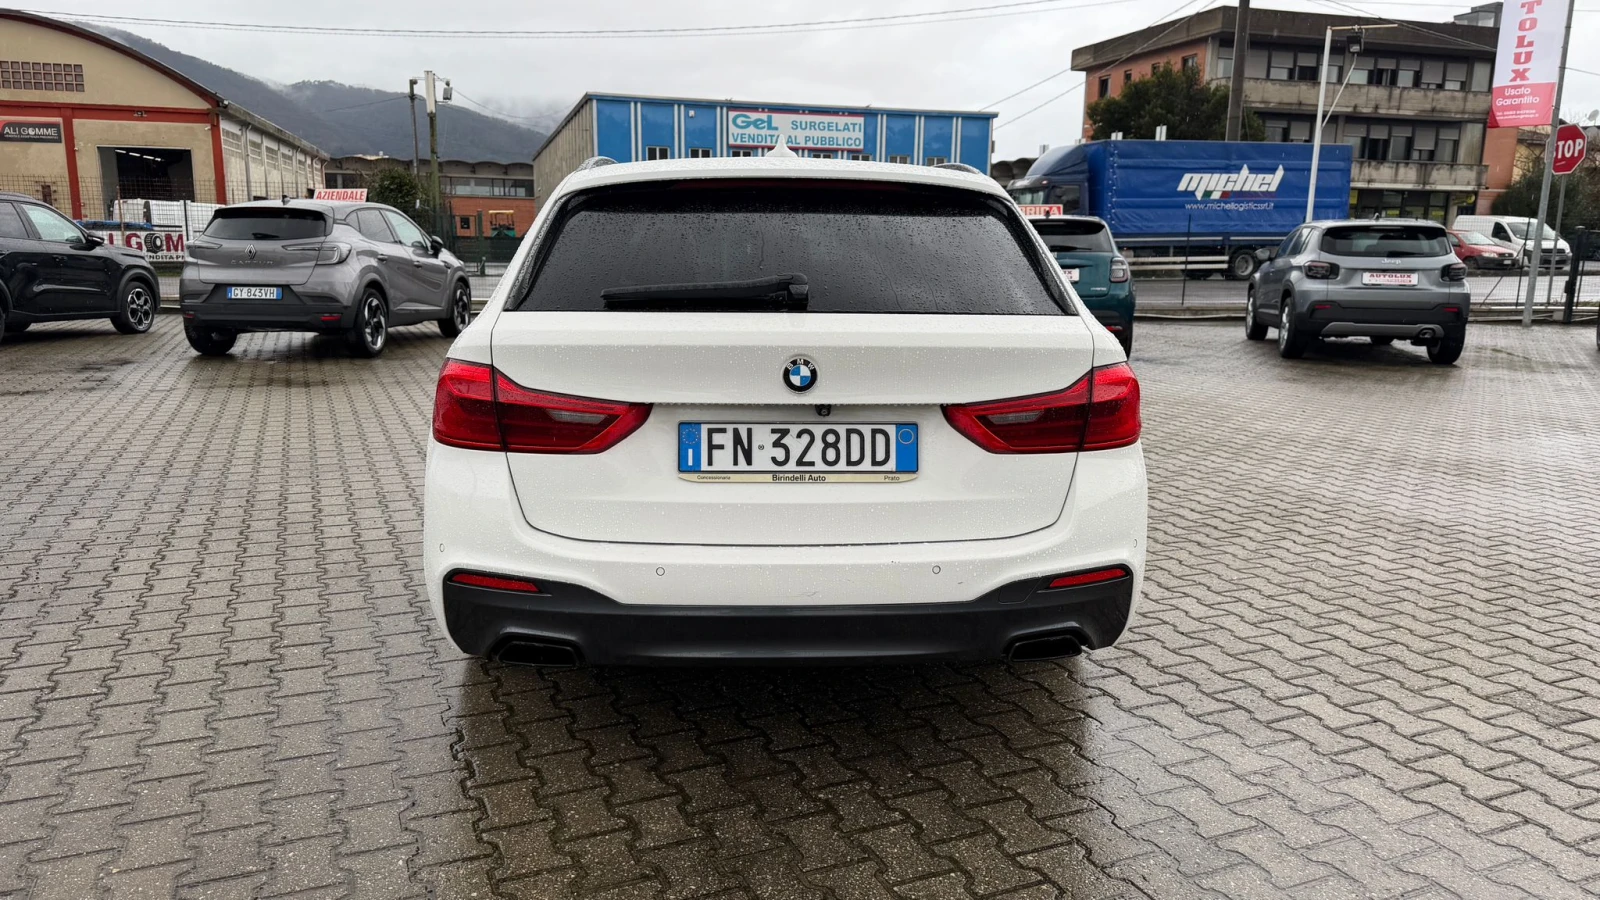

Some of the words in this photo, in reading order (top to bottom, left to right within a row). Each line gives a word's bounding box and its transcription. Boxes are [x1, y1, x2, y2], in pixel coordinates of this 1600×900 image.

[1509, 0, 1542, 82] TOLUX
[1504, 86, 1531, 96] Usato
[1495, 96, 1540, 106] Garantito
[4, 126, 19, 135] ALI
[20, 127, 58, 136] GOMME
[791, 120, 861, 132] SURGELATI
[786, 135, 800, 145] AL
[804, 136, 861, 147] PUBBLICO
[1177, 164, 1285, 200] michel
[315, 190, 365, 201] AZIENDALE
[125, 233, 184, 253] GOM
[246, 288, 275, 298] 843VH
[786, 358, 815, 370] BMW
[707, 427, 753, 466] FN
[770, 428, 891, 467] 328DD
[772, 474, 806, 482] Birindelli
[808, 474, 827, 482] Auto
